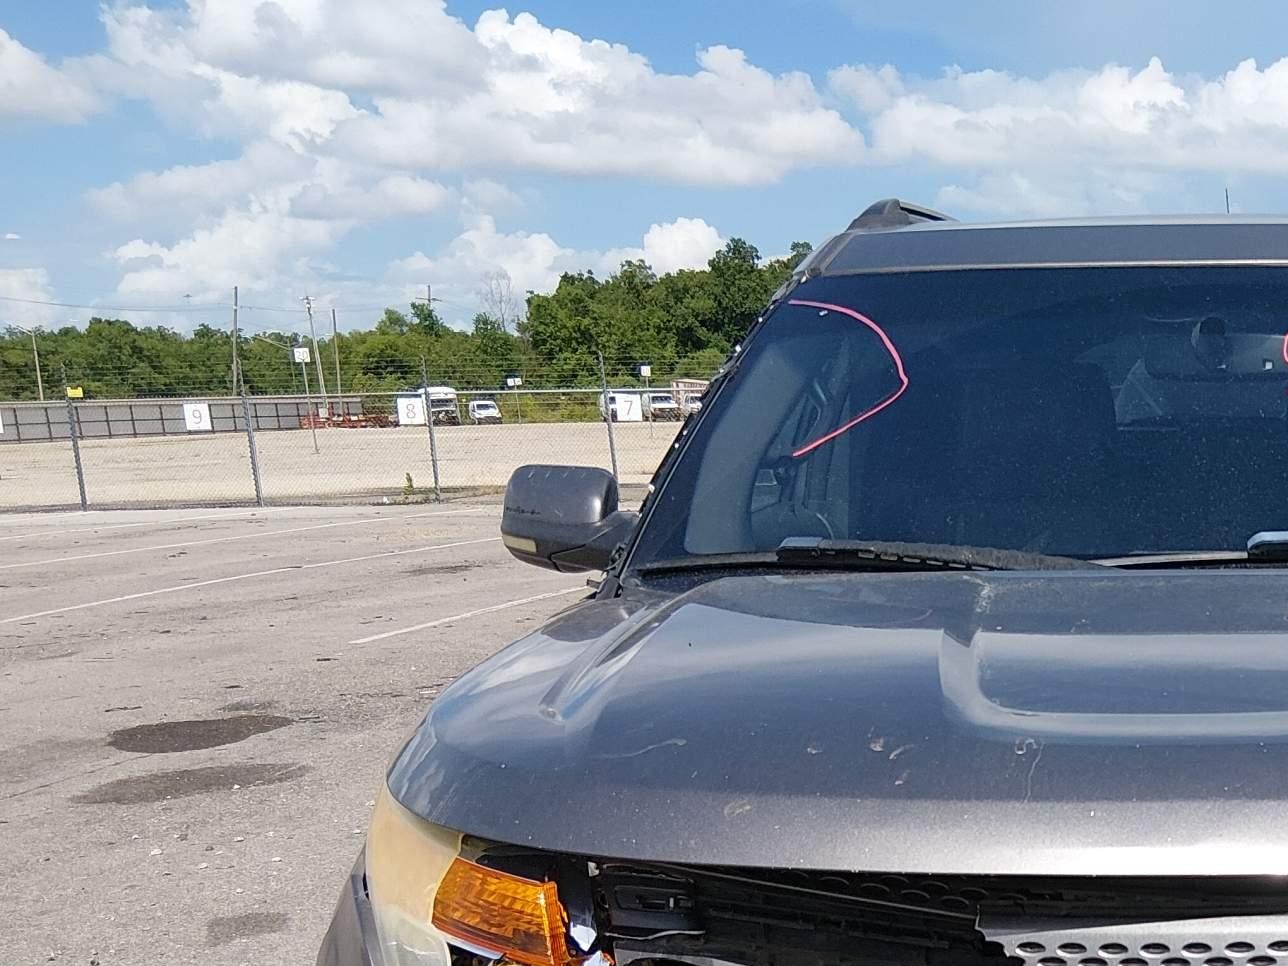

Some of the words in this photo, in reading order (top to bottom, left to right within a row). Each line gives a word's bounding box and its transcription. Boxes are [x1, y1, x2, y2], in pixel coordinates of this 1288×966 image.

[406, 403, 417, 419] 8
[623, 400, 633, 417] 7
[192, 409, 202, 425] 9
